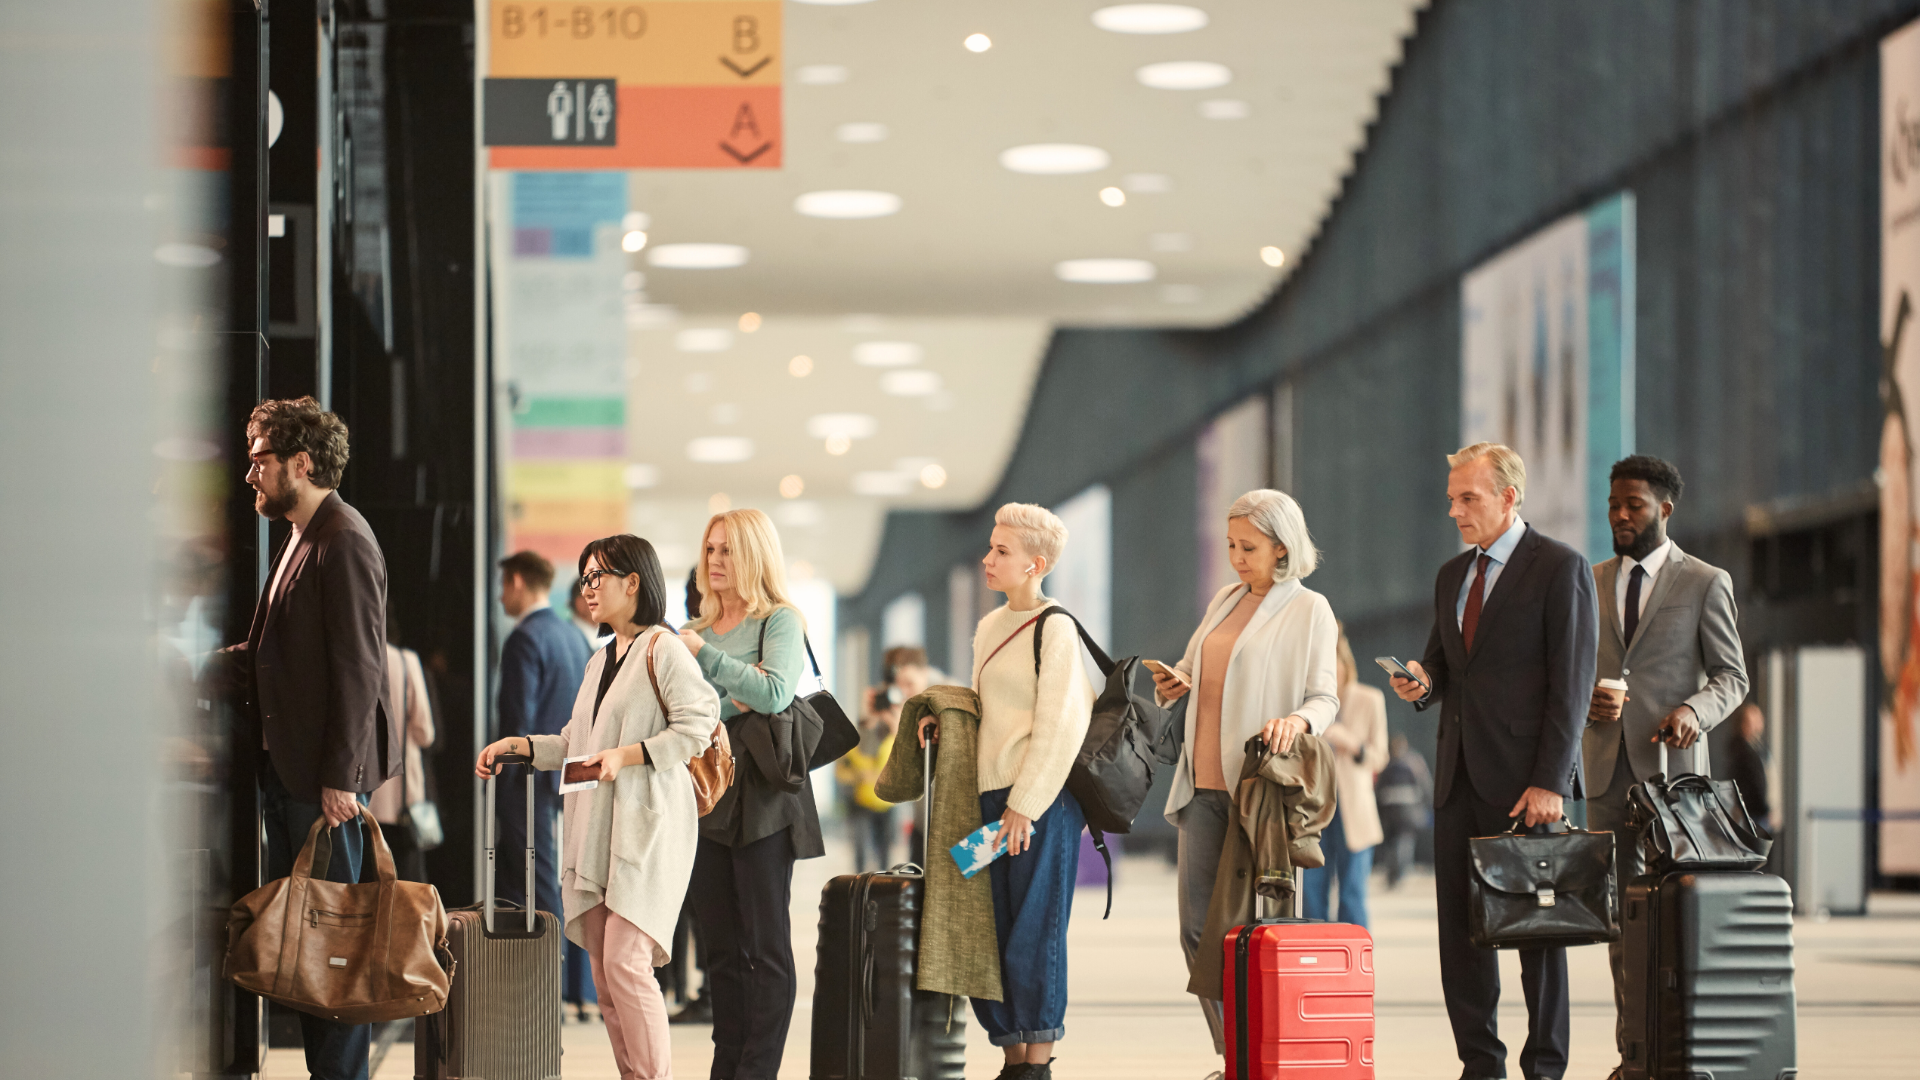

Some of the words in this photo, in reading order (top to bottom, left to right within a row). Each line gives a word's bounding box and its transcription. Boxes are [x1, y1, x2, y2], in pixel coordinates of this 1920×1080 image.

[502, 5, 648, 40] B1-B10
[733, 14, 760, 54] B
[731, 101, 760, 138] A
